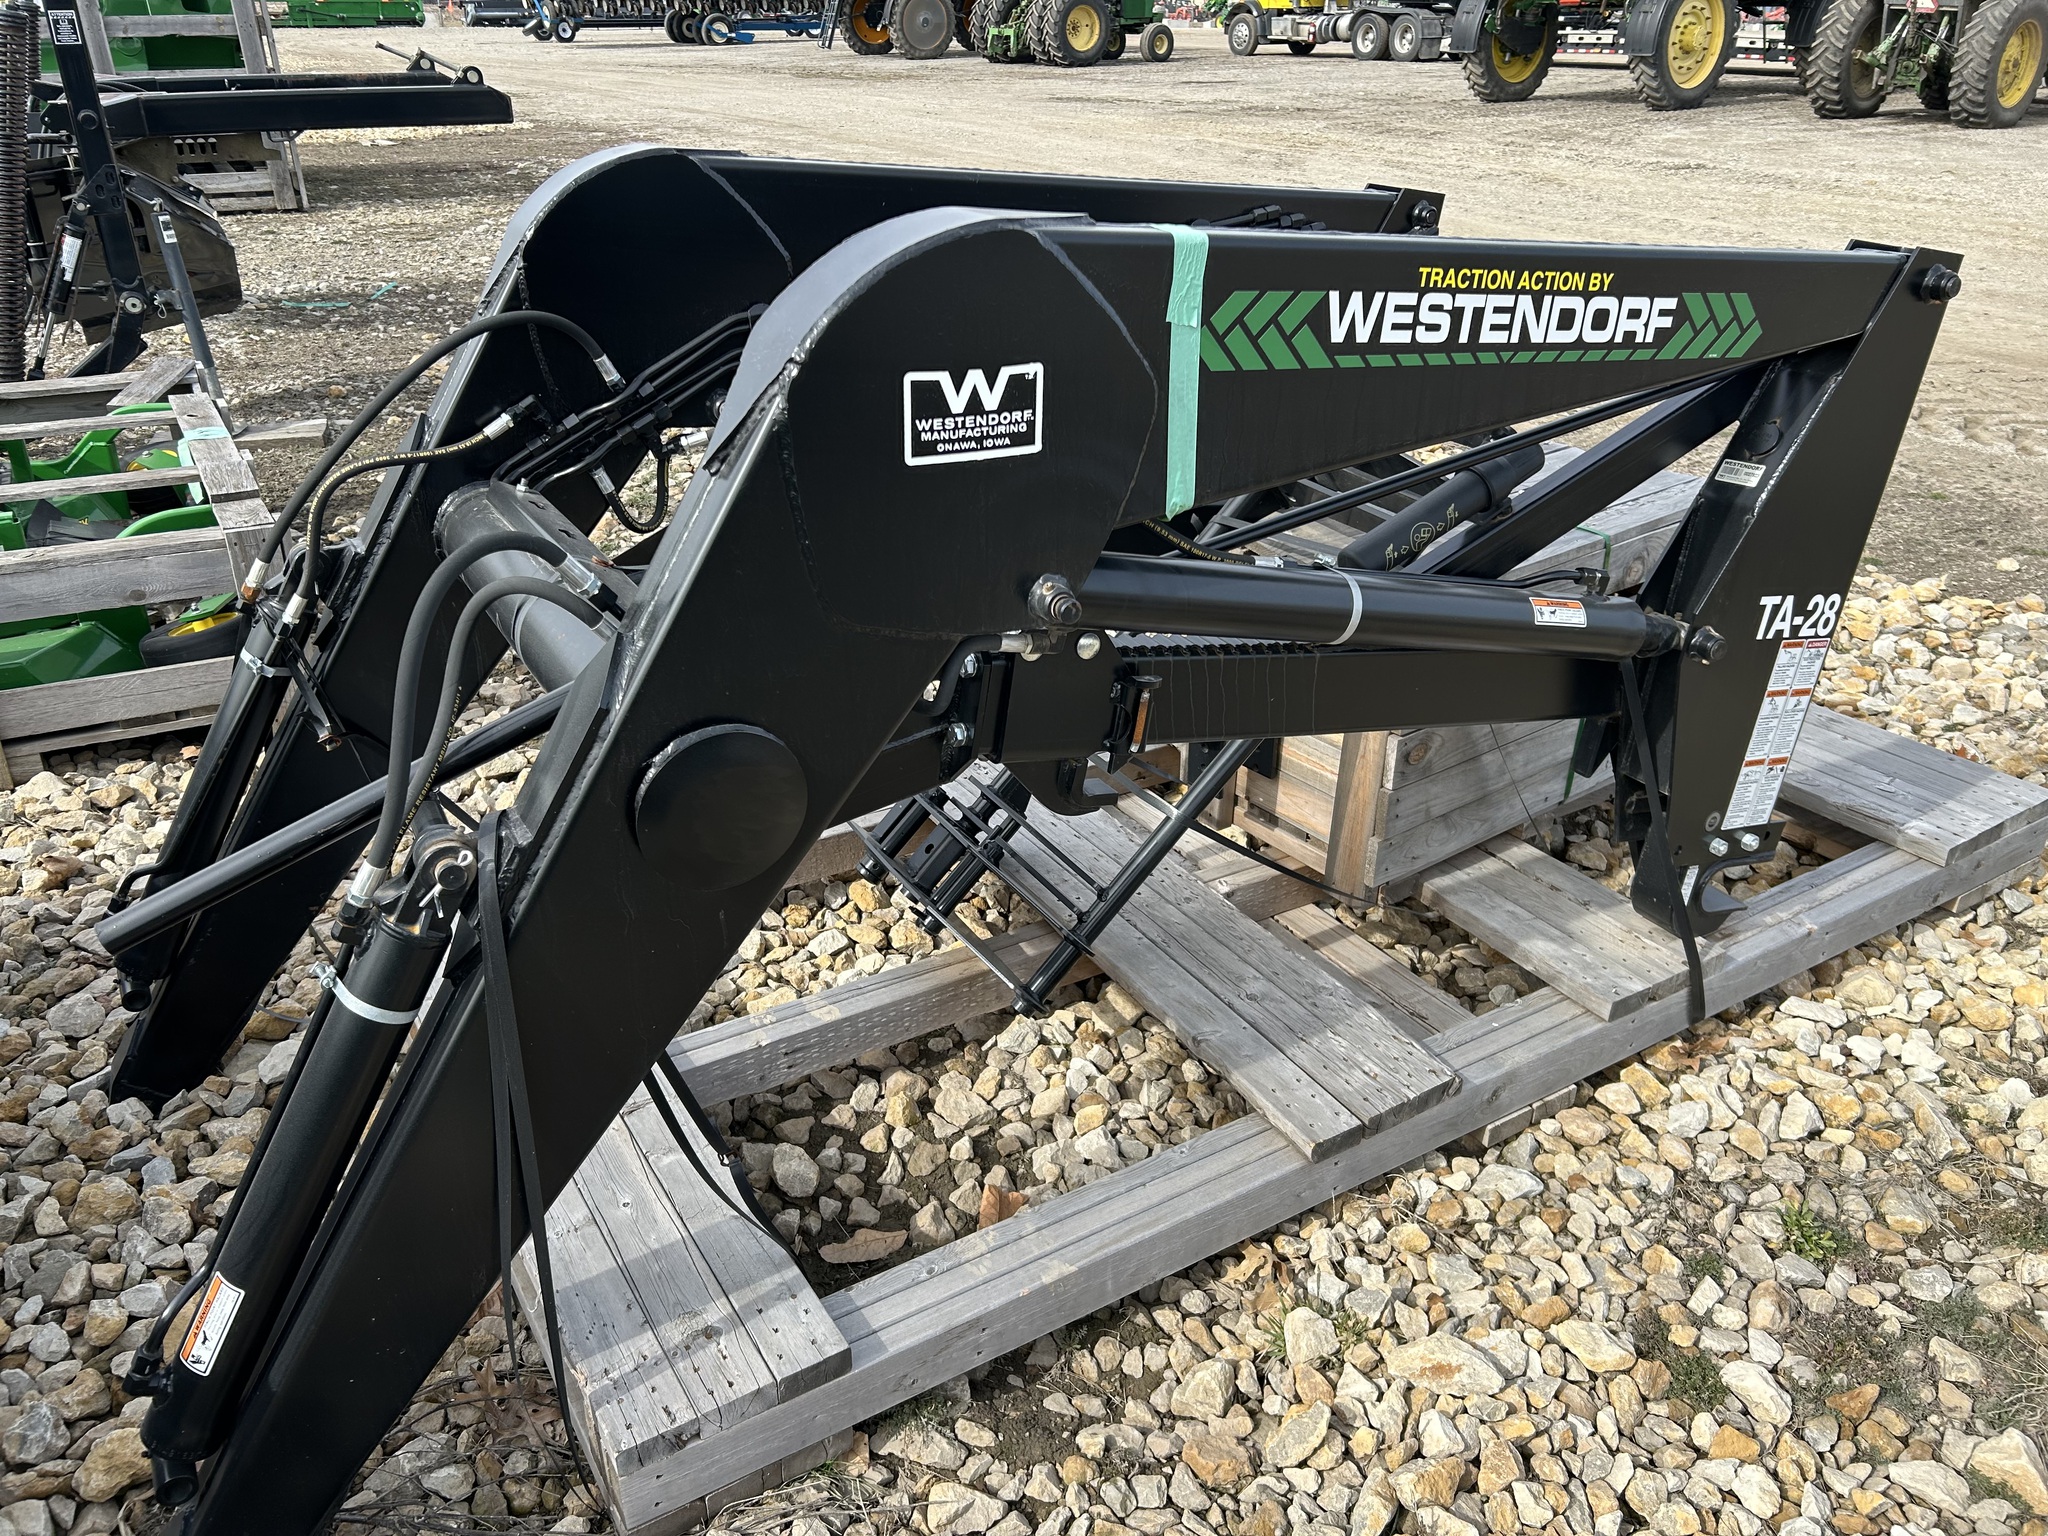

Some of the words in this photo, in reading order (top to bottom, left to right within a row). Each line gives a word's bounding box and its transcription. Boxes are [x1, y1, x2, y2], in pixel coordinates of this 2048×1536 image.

[1418, 267, 1515, 290] TRACTION
[1517, 270, 1586, 291] ACTION
[1588, 273, 1614, 292] BY
[1328, 290, 1678, 344] WESTENDORF
[920, 422, 1027, 441] MANUFACTURING
[936, 440, 981, 452] ONAWA,
[983, 437, 1011, 448] IOWA
[1724, 461, 1763, 470] WESTENDORF
[1180, 542, 1191, 550] SAE
[1755, 593, 1841, 640] TA-28
[399, 806, 417, 834] FLAME
[415, 762, 440, 806] RESISTANT
[437, 740, 449, 762] MSHA
[195, 1299, 211, 1330] WARNING
